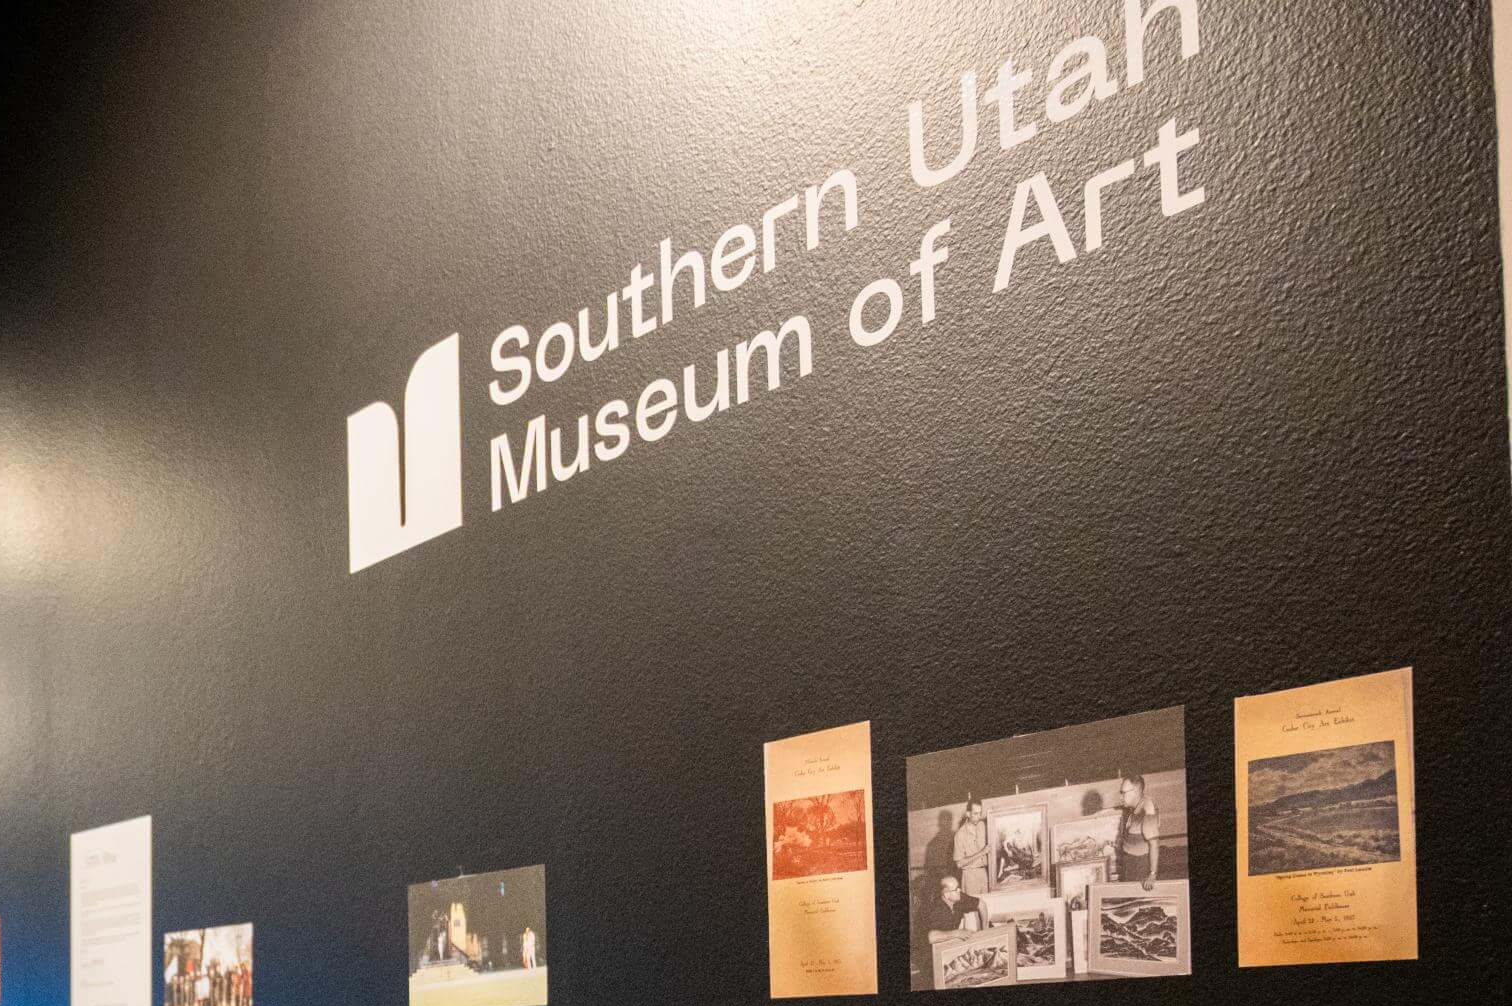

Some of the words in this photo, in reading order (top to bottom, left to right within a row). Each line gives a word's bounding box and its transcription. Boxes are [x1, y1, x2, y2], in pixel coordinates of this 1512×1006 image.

[489, 168, 859, 405] Southern
[909, 0, 1201, 186] Utah
[492, 315, 812, 513] Museum
[849, 220, 951, 347] of
[993, 117, 1206, 293] Art
